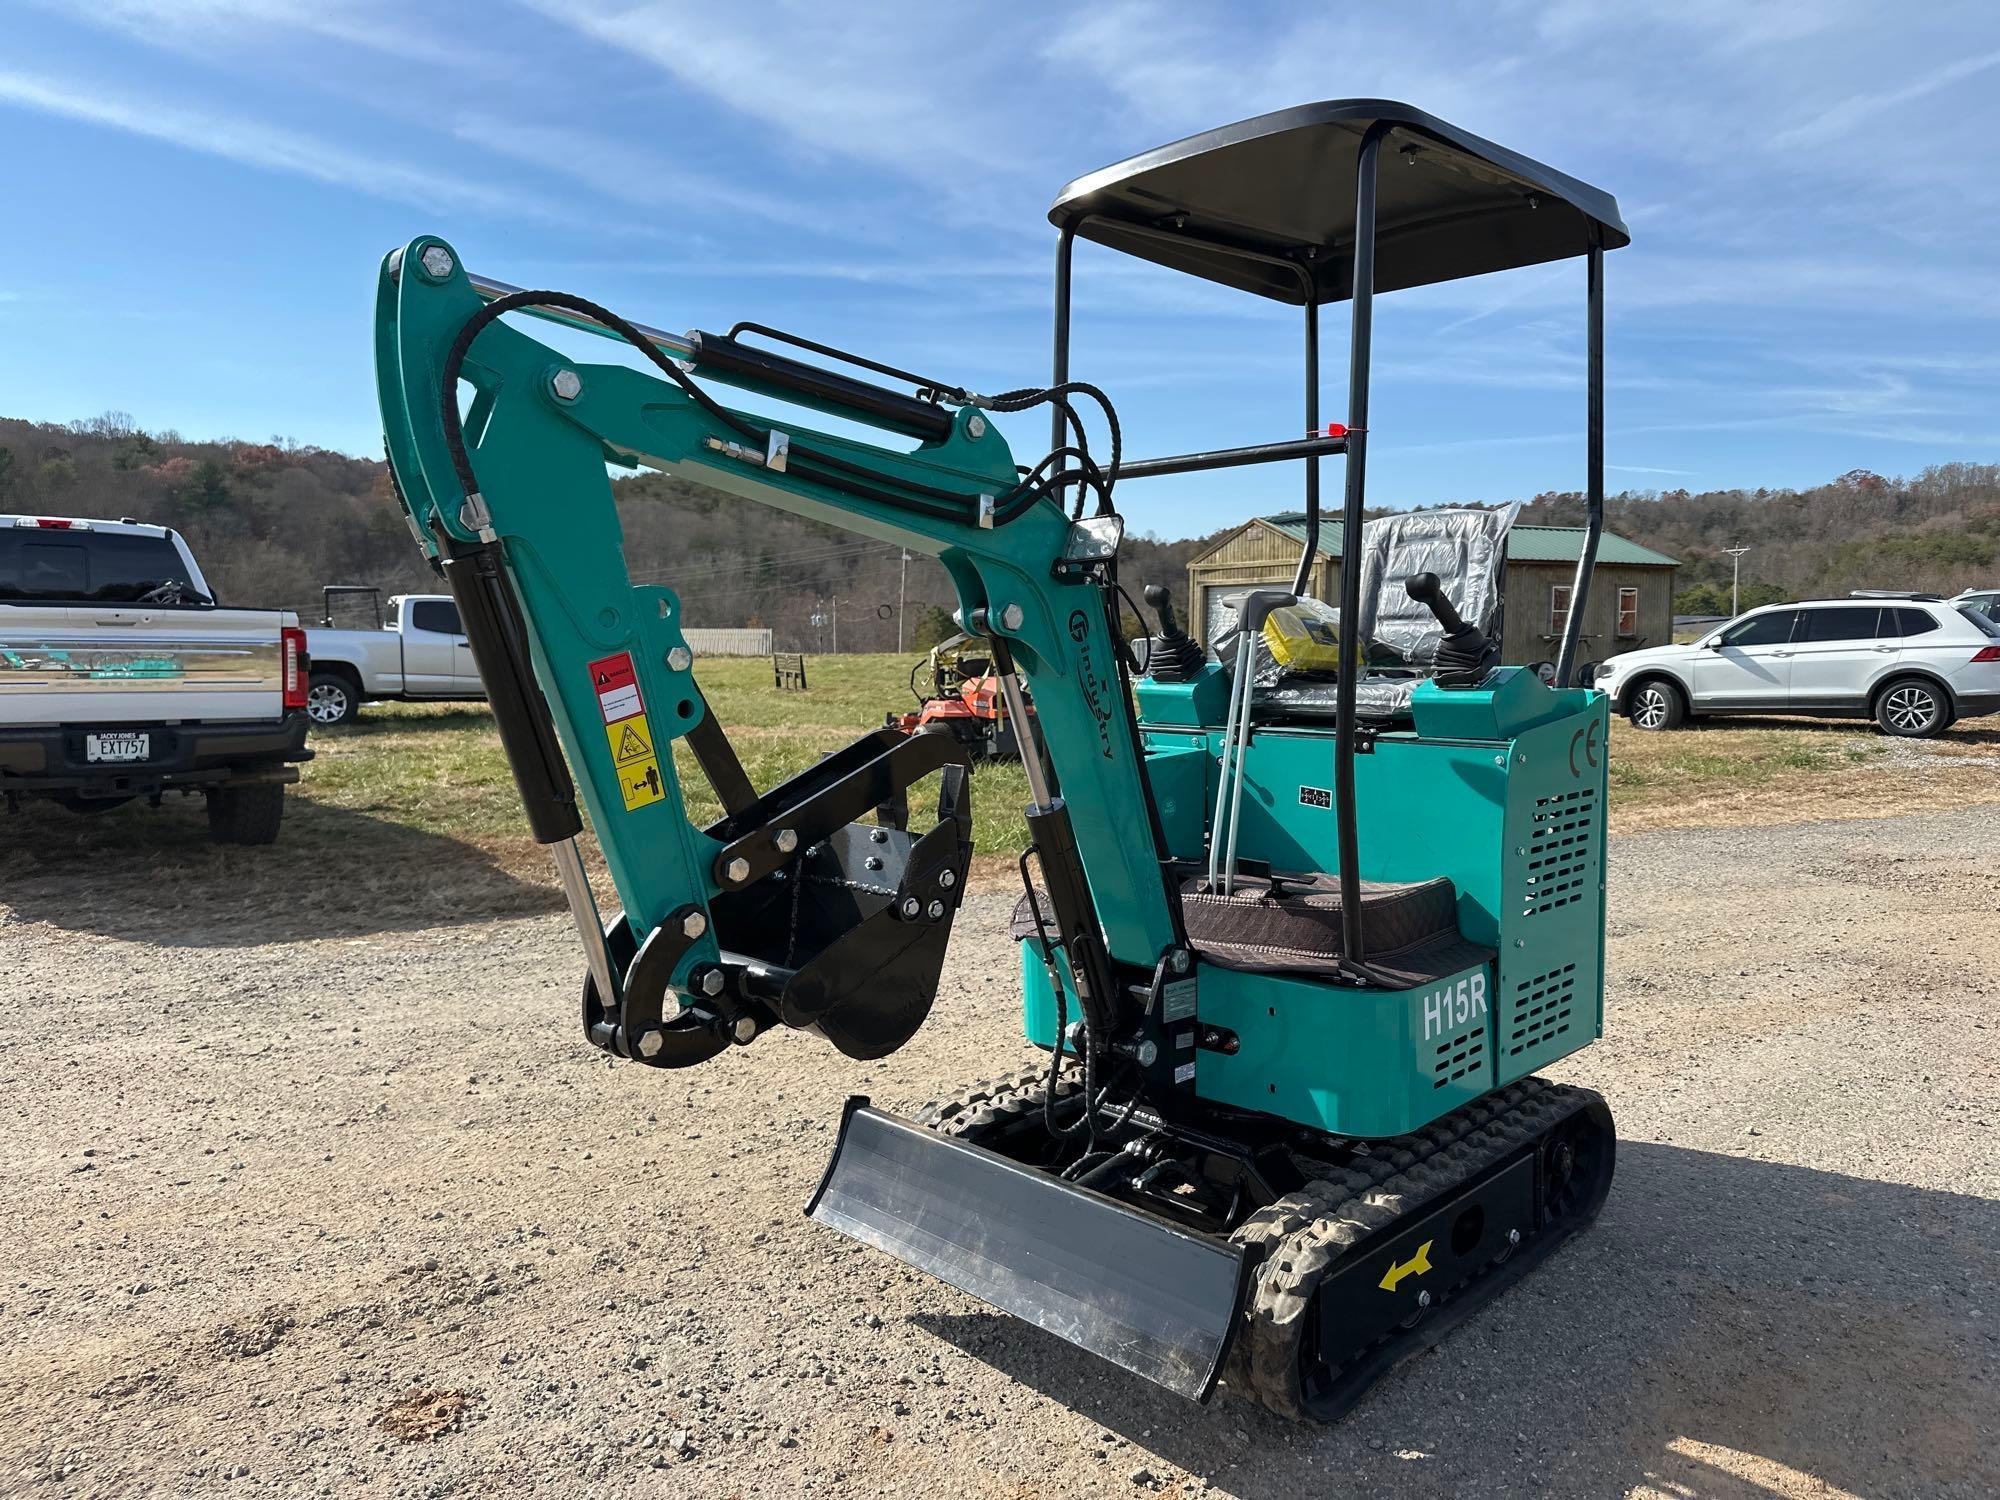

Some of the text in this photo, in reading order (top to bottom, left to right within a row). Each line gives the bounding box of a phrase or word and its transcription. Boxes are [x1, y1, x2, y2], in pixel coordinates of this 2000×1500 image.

[102, 740, 146, 754] EXT757
[1569, 718, 1600, 779] CE
[1423, 972, 1488, 1041] H15R
